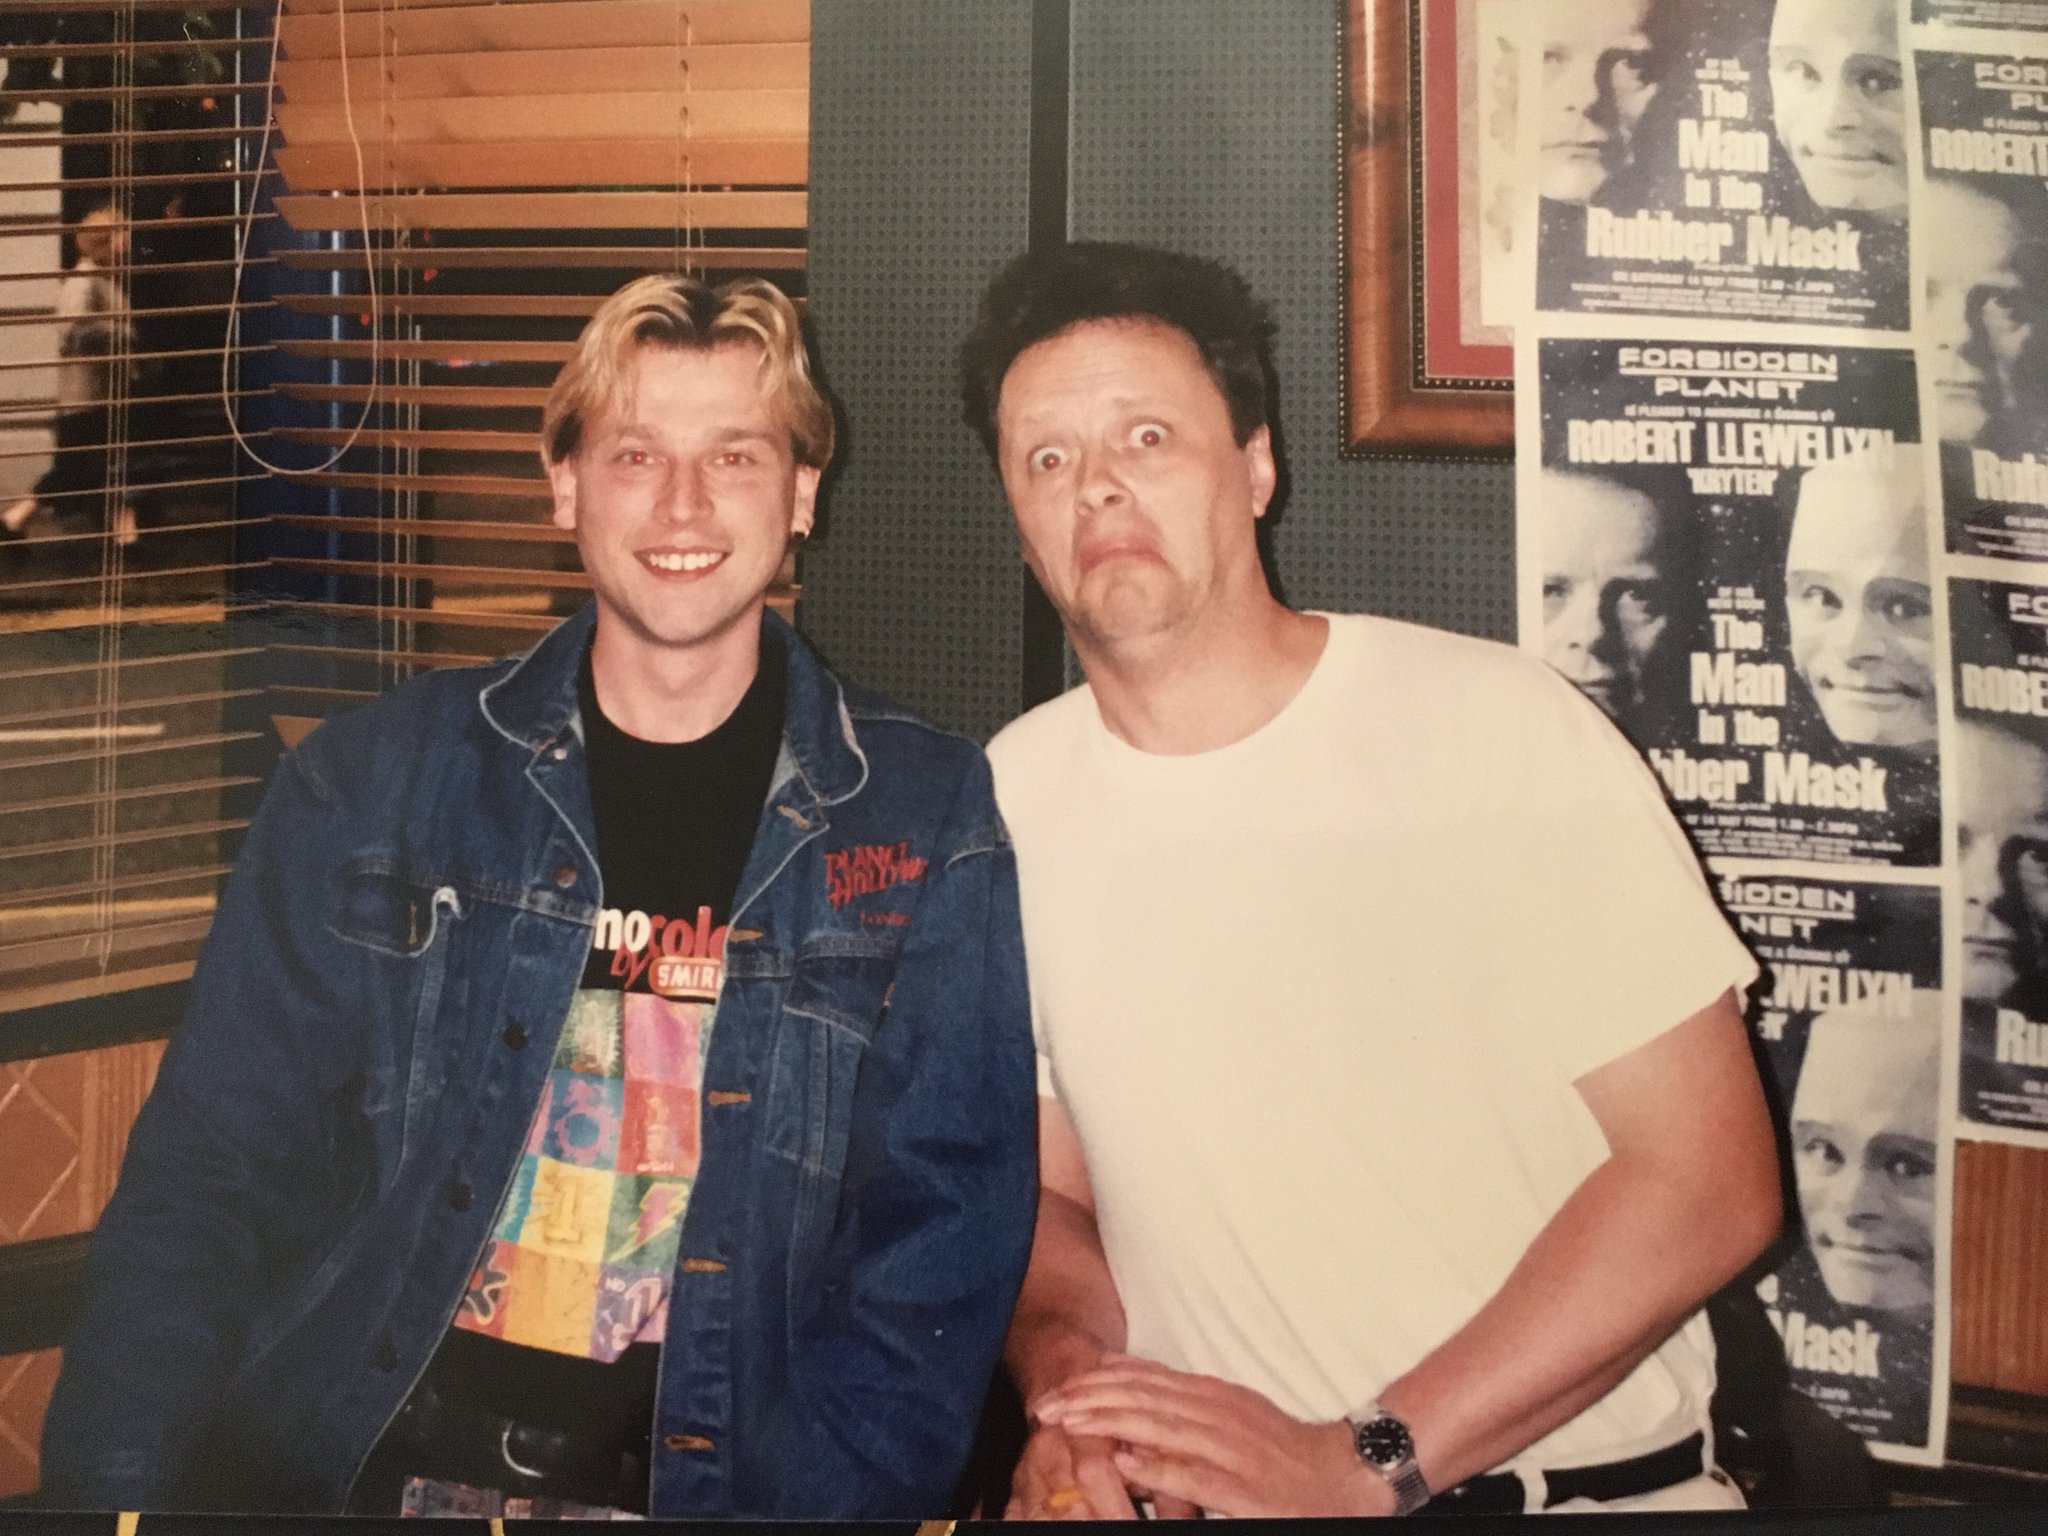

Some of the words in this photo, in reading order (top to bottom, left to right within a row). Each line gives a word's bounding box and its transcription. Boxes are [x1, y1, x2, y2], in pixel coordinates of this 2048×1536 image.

[1698, 84, 1748, 118] The
[1678, 118, 1769, 172] Man
[1719, 174, 1763, 210] the
[1587, 207, 1733, 263] Rubber
[1747, 215, 1861, 271] Mask
[1618, 348, 1838, 374] FORBIDDEN
[1654, 377, 1804, 402] PLANET
[1567, 418, 1697, 464] ROBERT
[1706, 420, 1894, 473] LLEWELLYN
[1710, 612, 1763, 651] The
[1690, 651, 1787, 706] Man
[1733, 709, 1779, 747] the
[1763, 751, 1888, 812] Mask
[1720, 880, 1856, 914] IDDEN
[610, 944, 651, 989] by
